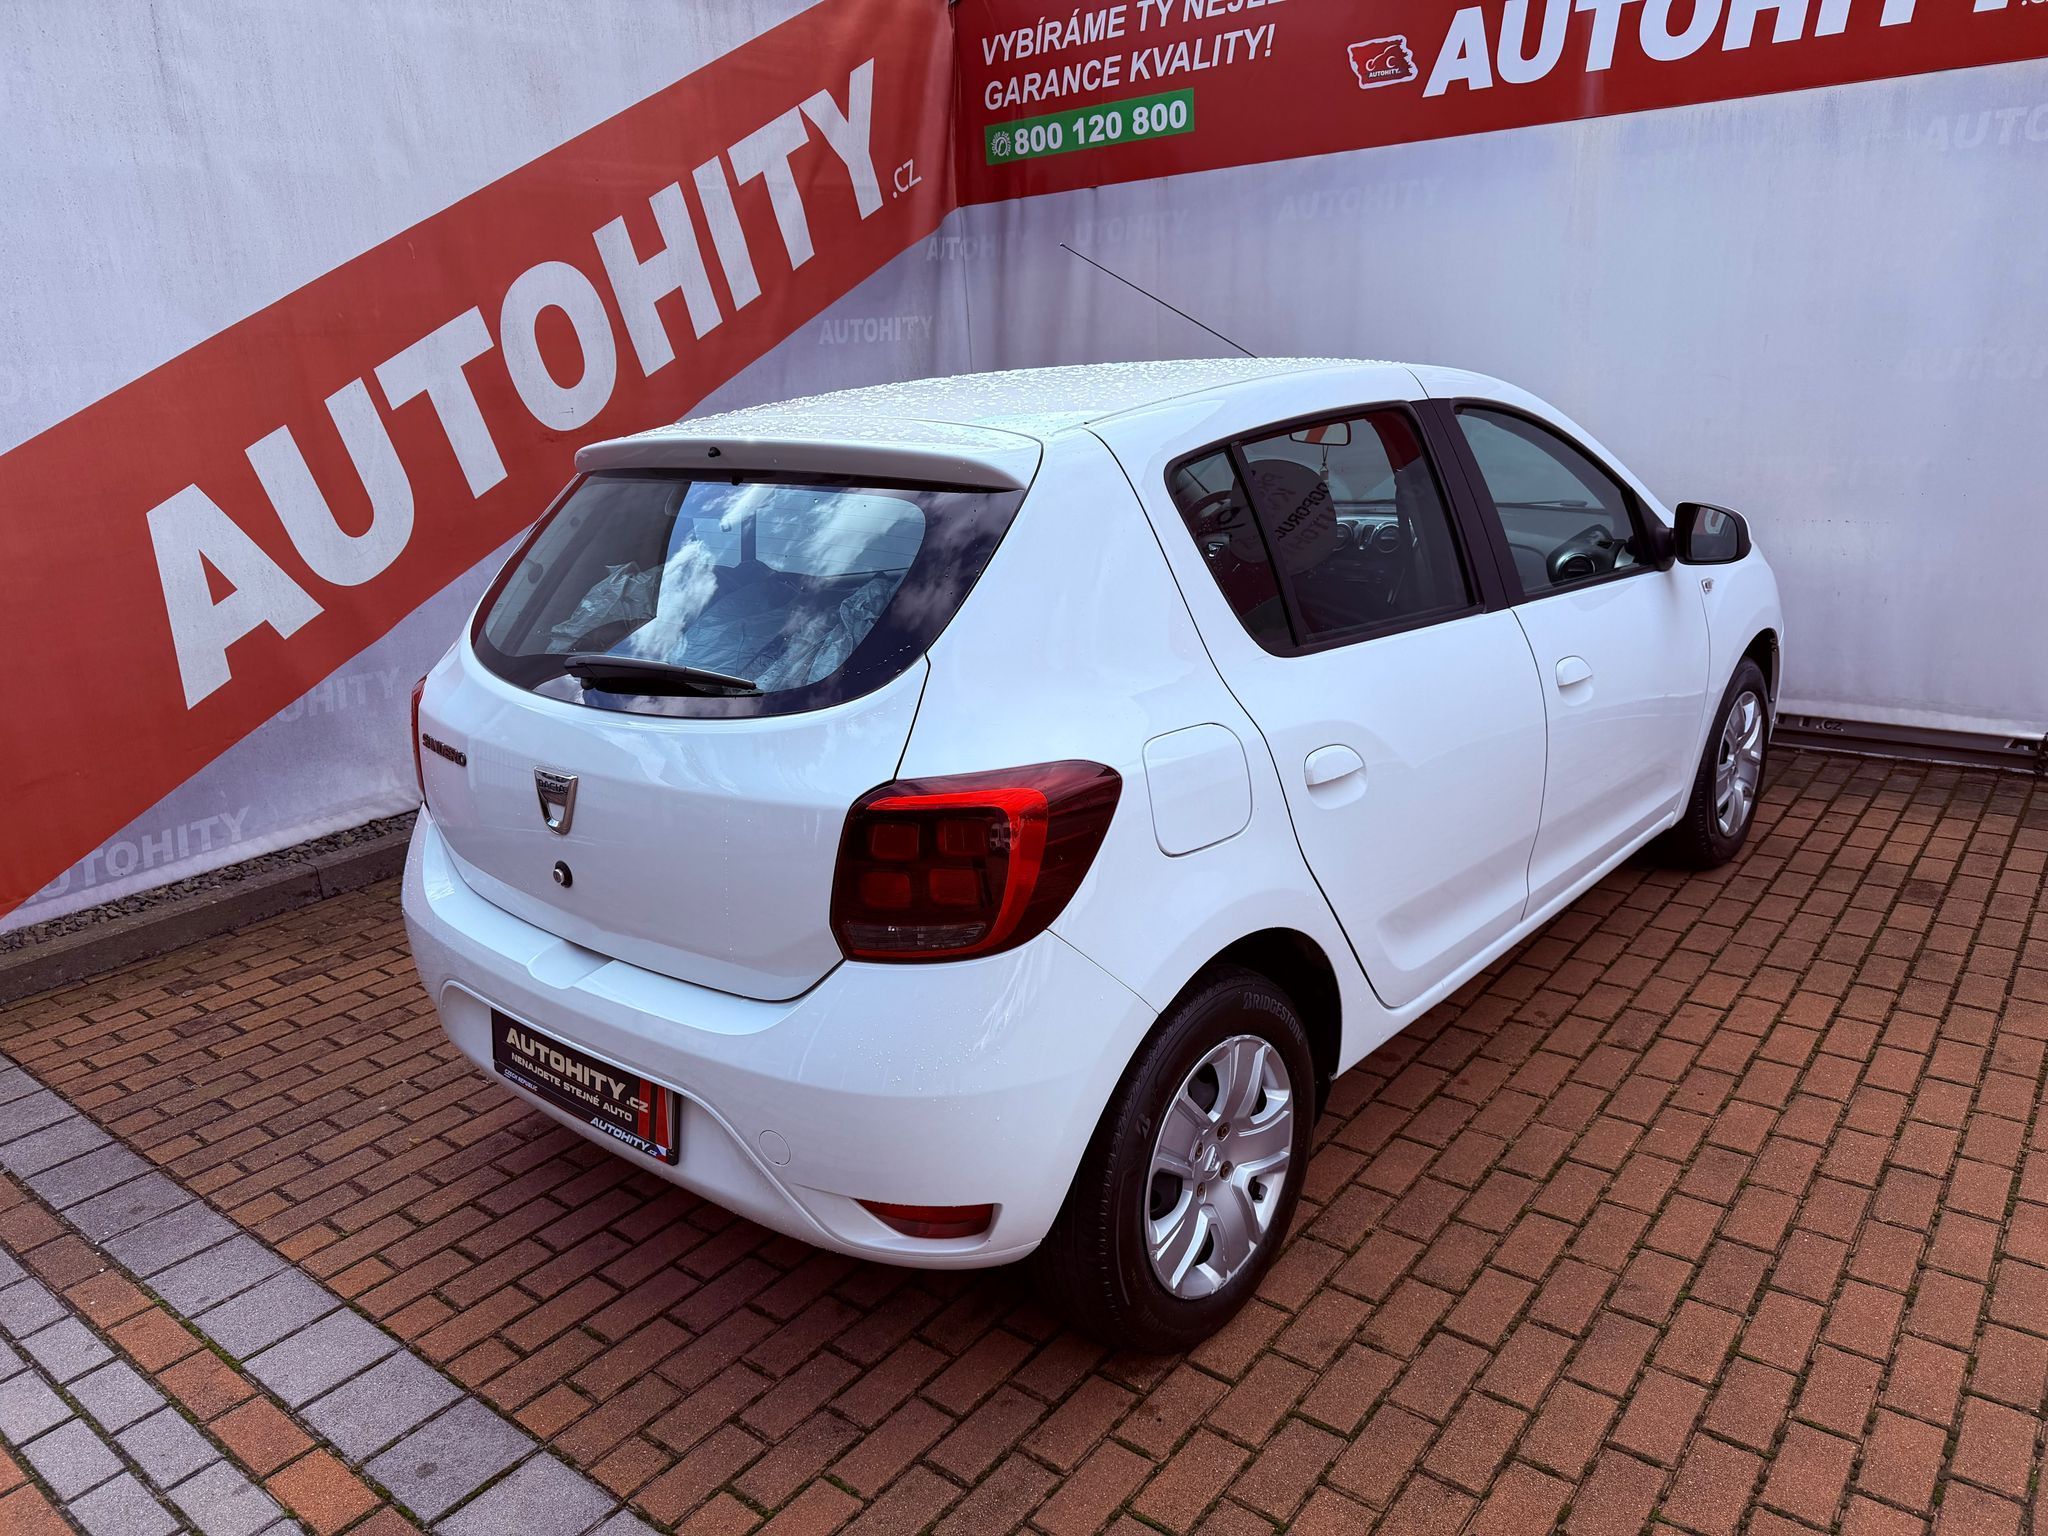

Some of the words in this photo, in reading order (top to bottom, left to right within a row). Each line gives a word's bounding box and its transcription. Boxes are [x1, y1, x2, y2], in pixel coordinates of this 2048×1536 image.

[981, 4, 1127, 65] VYBÍRÁME
[1136, 0, 1174, 32] TY
[984, 54, 1122, 111] GARANCE
[1129, 23, 1276, 83] KVALITY!
[1014, 122, 1063, 155] 800
[1072, 111, 1123, 145] 120
[1132, 100, 1187, 135] 800
[818, 315, 934, 345] AUTOHITY
[511, 1052, 561, 1087] NENAJDETE
[563, 1082, 600, 1107] STEJNÉ
[602, 1102, 633, 1122] AUTO
